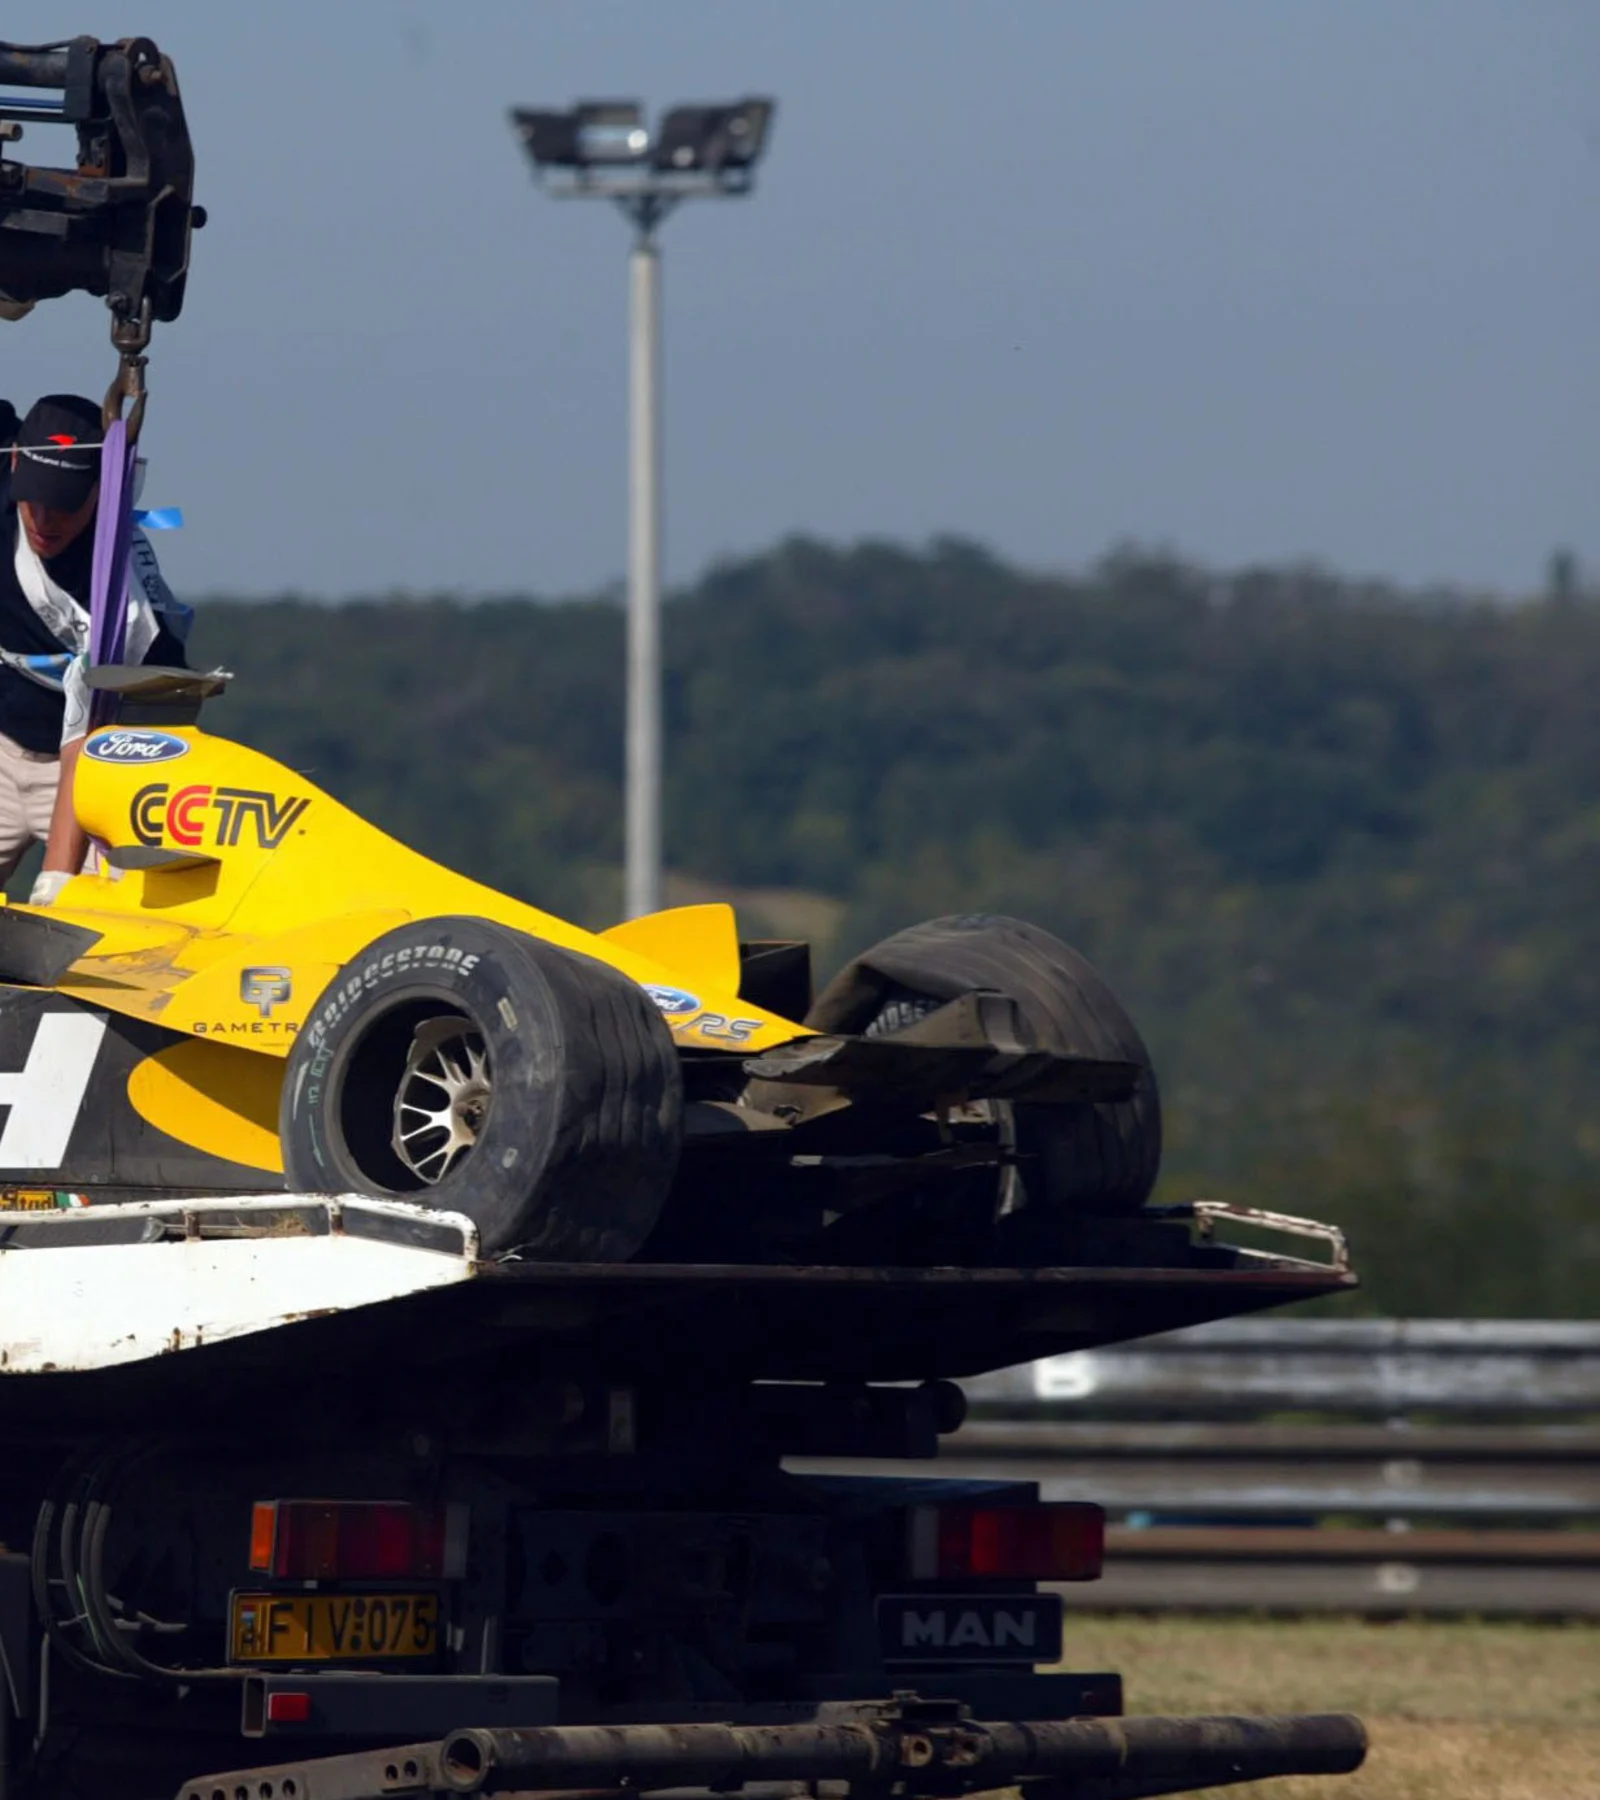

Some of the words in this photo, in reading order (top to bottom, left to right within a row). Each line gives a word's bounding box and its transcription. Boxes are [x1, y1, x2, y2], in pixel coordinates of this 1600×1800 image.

[97, 731, 172, 758] Ford
[130, 783, 312, 849] CCTV
[901, 1609, 1036, 1648] MAN
